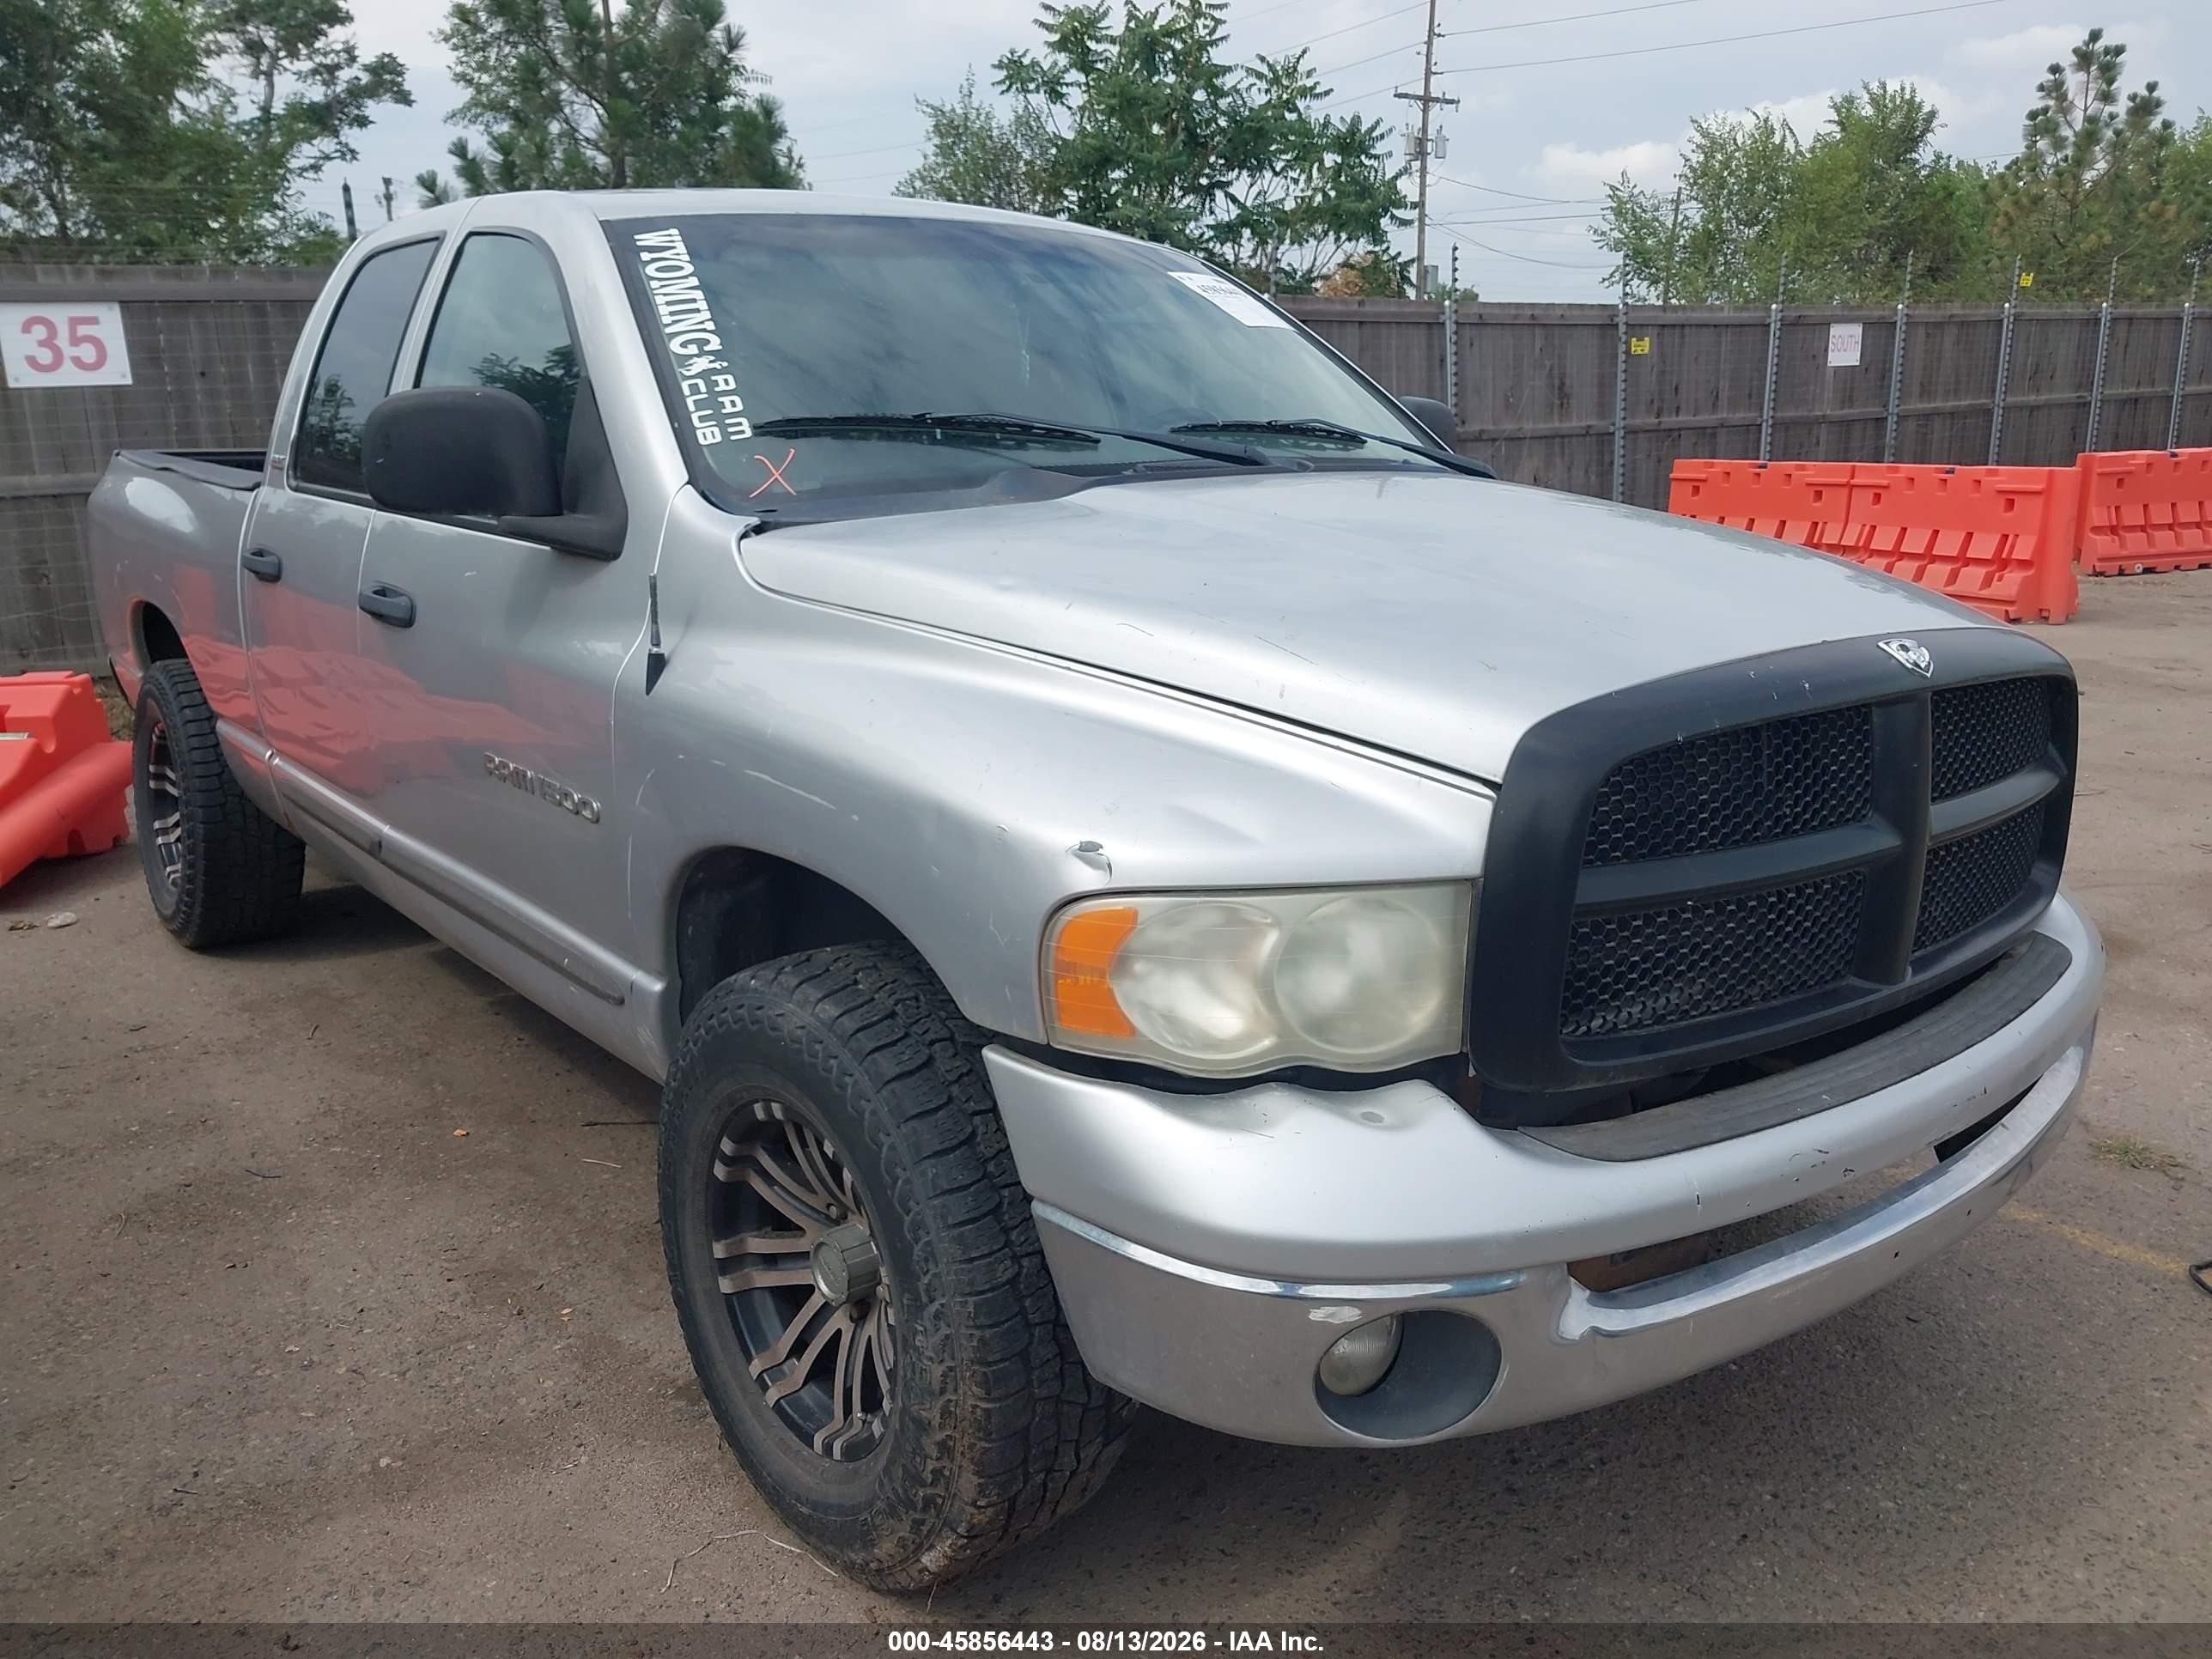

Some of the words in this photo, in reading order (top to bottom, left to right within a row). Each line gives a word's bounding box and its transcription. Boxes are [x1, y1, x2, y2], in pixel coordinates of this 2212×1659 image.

[633, 228, 722, 355] WYOMING
[21, 315, 108, 373] 35
[1830, 335, 1860, 353] SOUTH
[681, 378, 722, 446] CLUB
[710, 374, 753, 441] RAM
